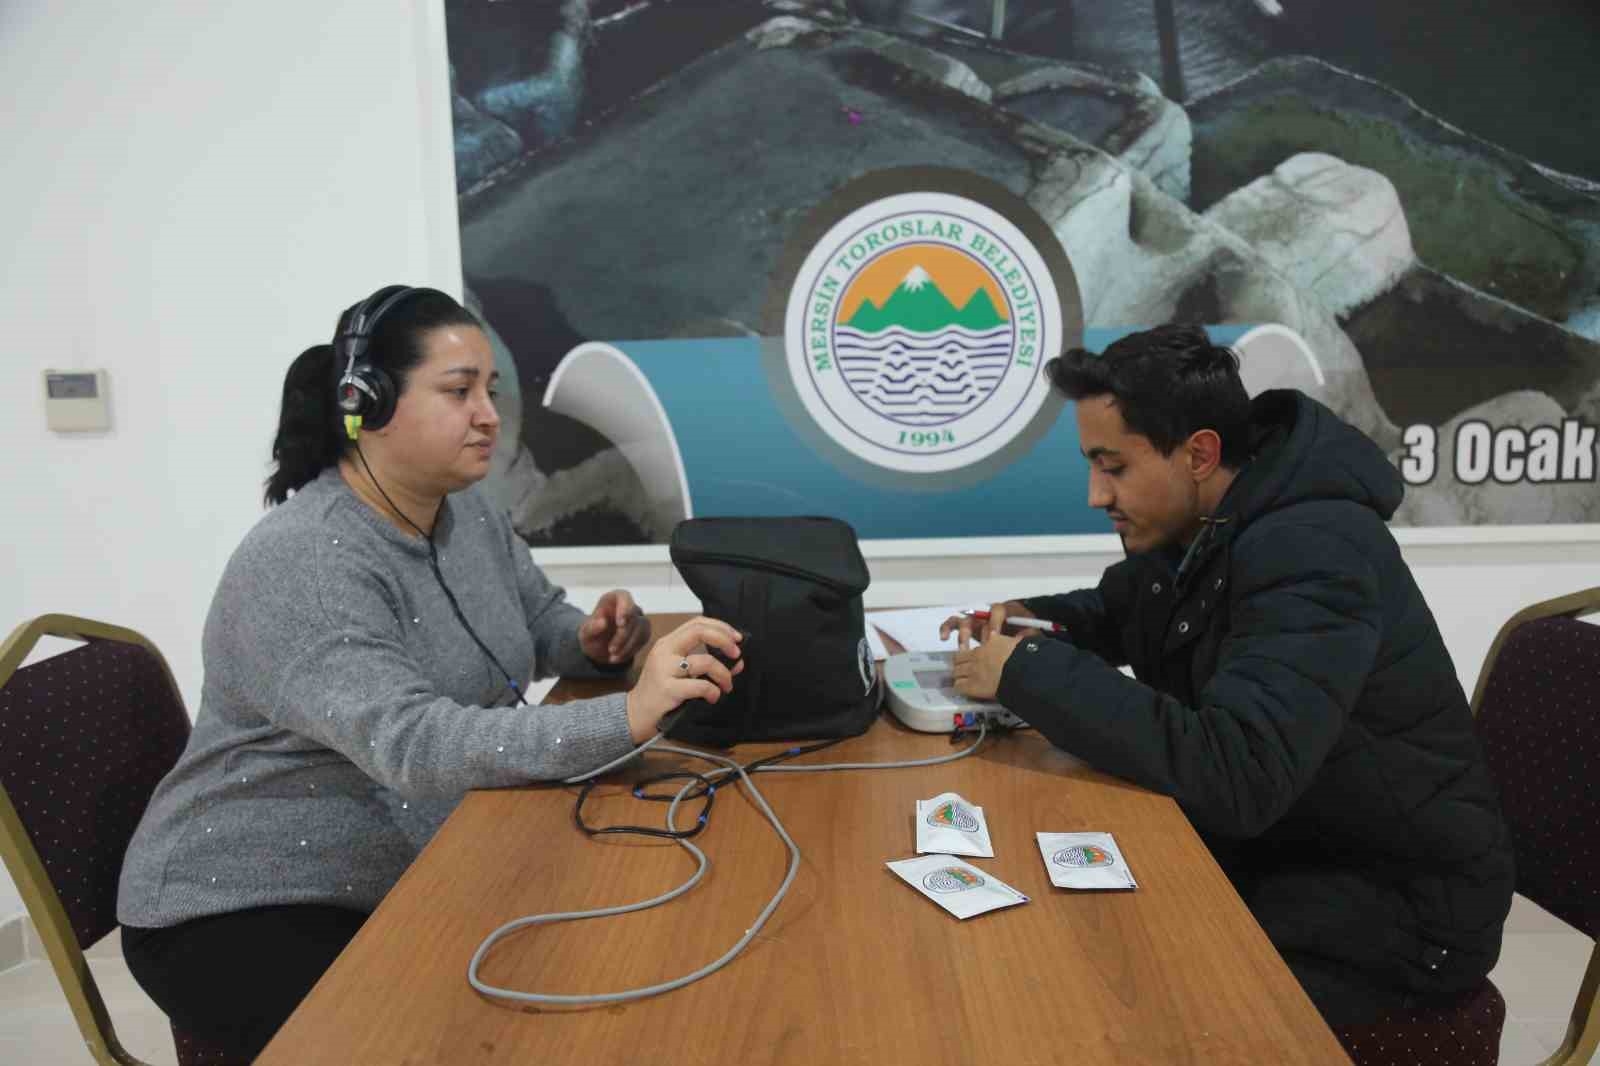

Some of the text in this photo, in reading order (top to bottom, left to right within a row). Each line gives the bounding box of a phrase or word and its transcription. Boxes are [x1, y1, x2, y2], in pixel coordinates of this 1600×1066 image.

[811, 274, 841, 372] MERSİN
[837, 219, 964, 271] TOROSLAR
[897, 430, 956, 448] 1994
[1401, 417, 1596, 485] 3 Ocak
